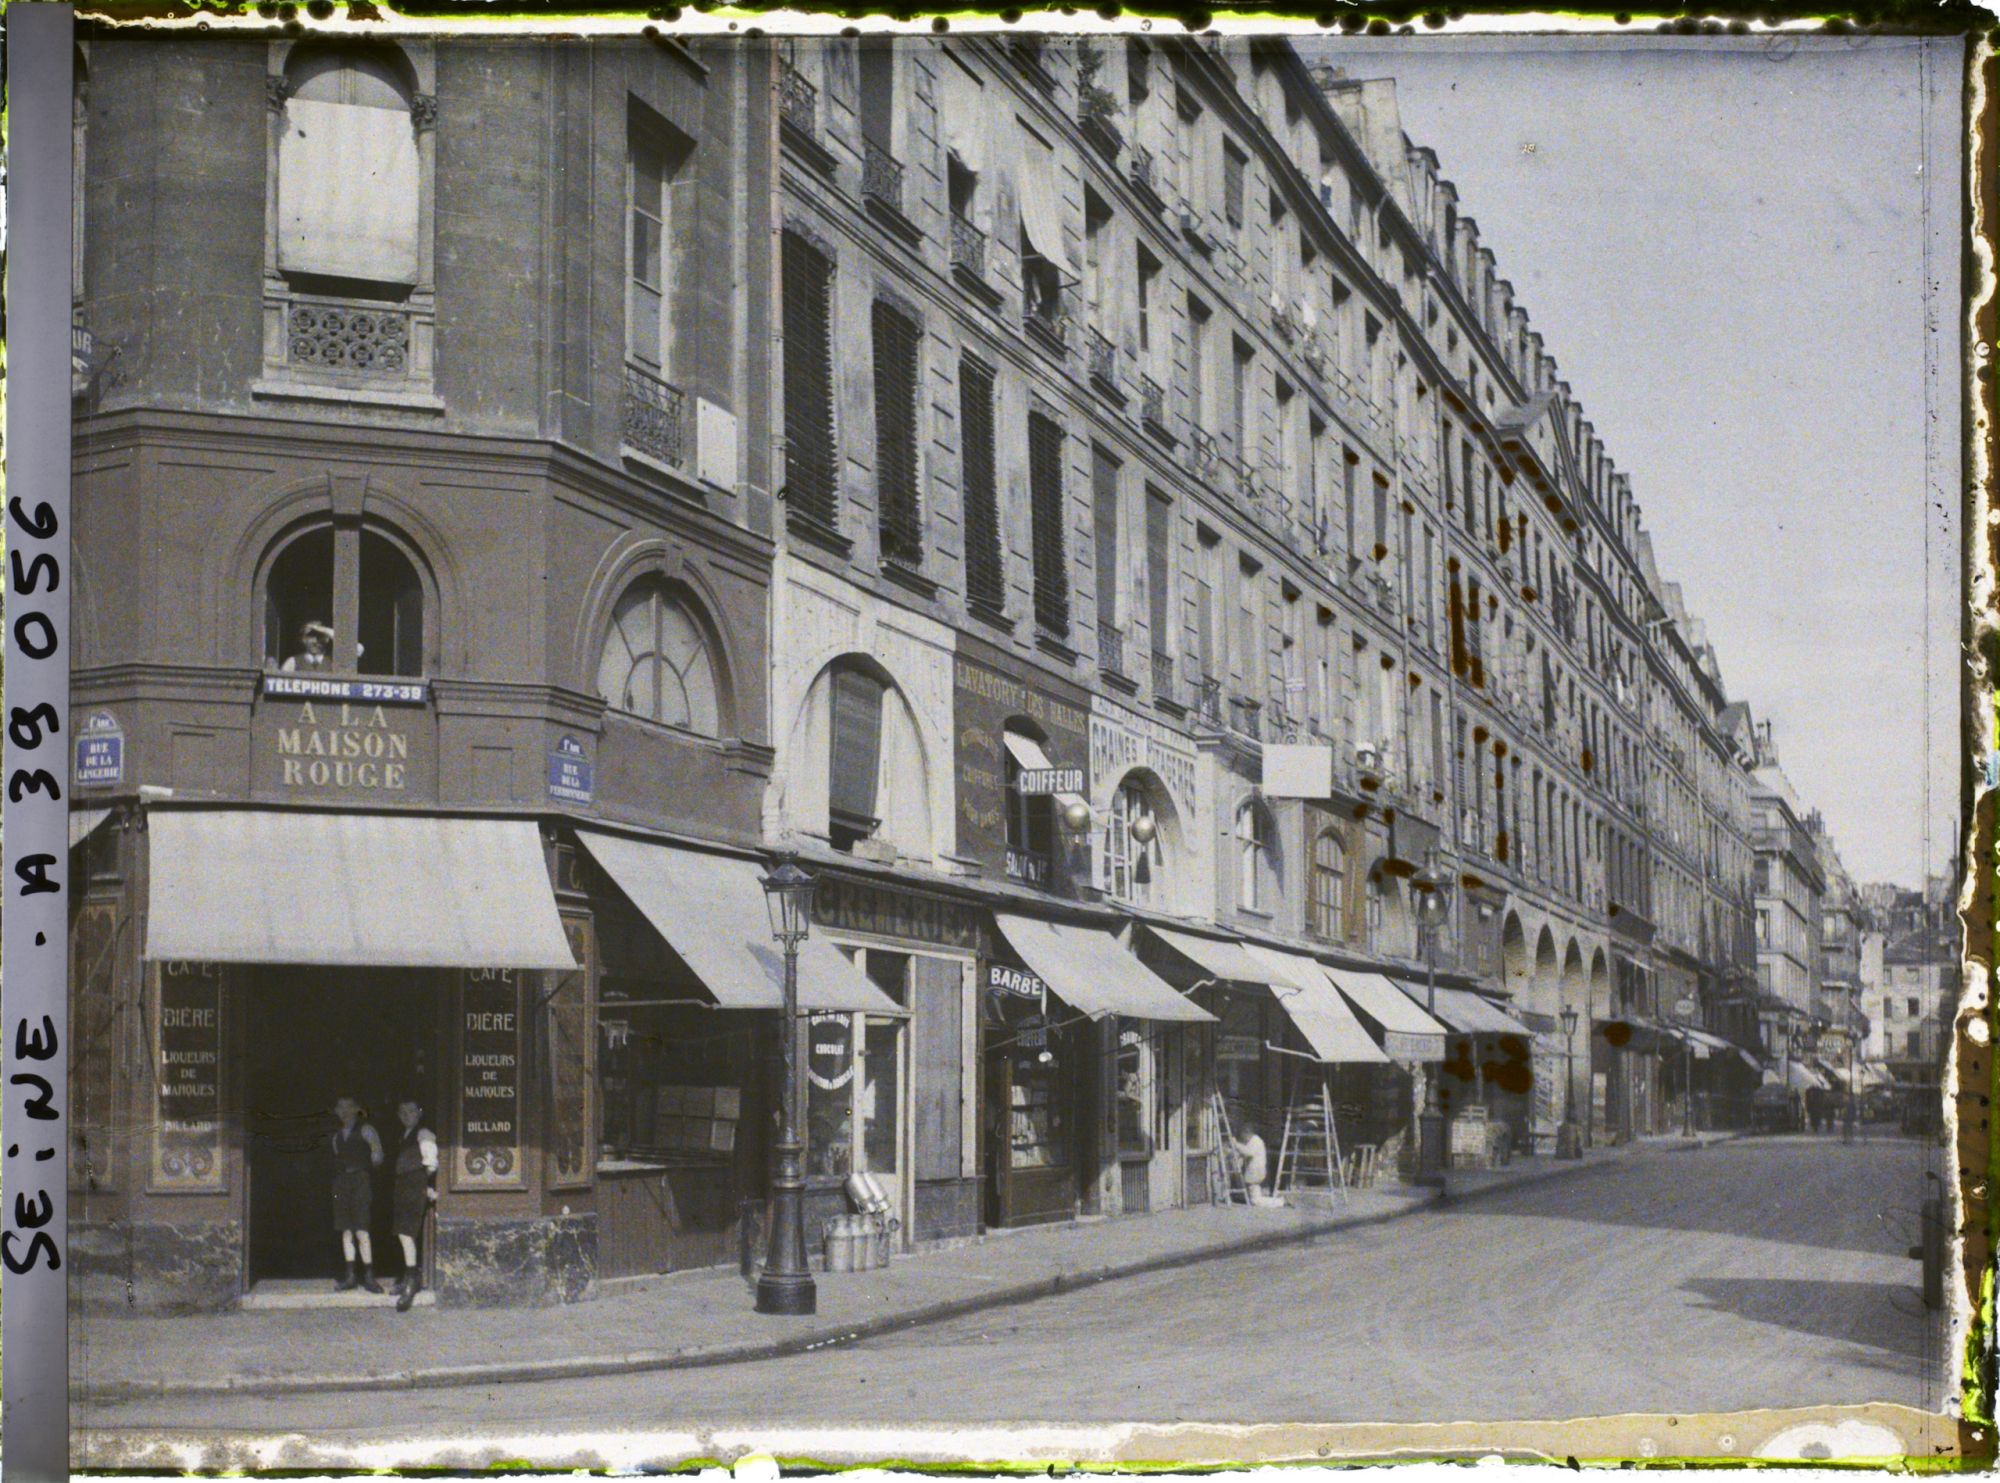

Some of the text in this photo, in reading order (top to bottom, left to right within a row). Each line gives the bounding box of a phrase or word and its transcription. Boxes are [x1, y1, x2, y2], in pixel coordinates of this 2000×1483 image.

[298, 701, 317, 725] A
[90, 742, 109, 754] RUE
[278, 728, 408, 760] MAISON
[100, 754, 113, 767] LA
[283, 759, 406, 790] ROUGE
[1019, 769, 1084, 793] COIFFEUR
[162, 1050, 216, 1064] LIQUEURS
[465, 1054, 515, 1067] LIQUEURS
[181, 1068, 196, 1079] DE
[482, 1071, 497, 1081] DE
[162, 1084, 215, 1097] MARQUES
[465, 1086, 514, 1099] MARQUES
[467, 1121, 511, 1133] BILLARD
